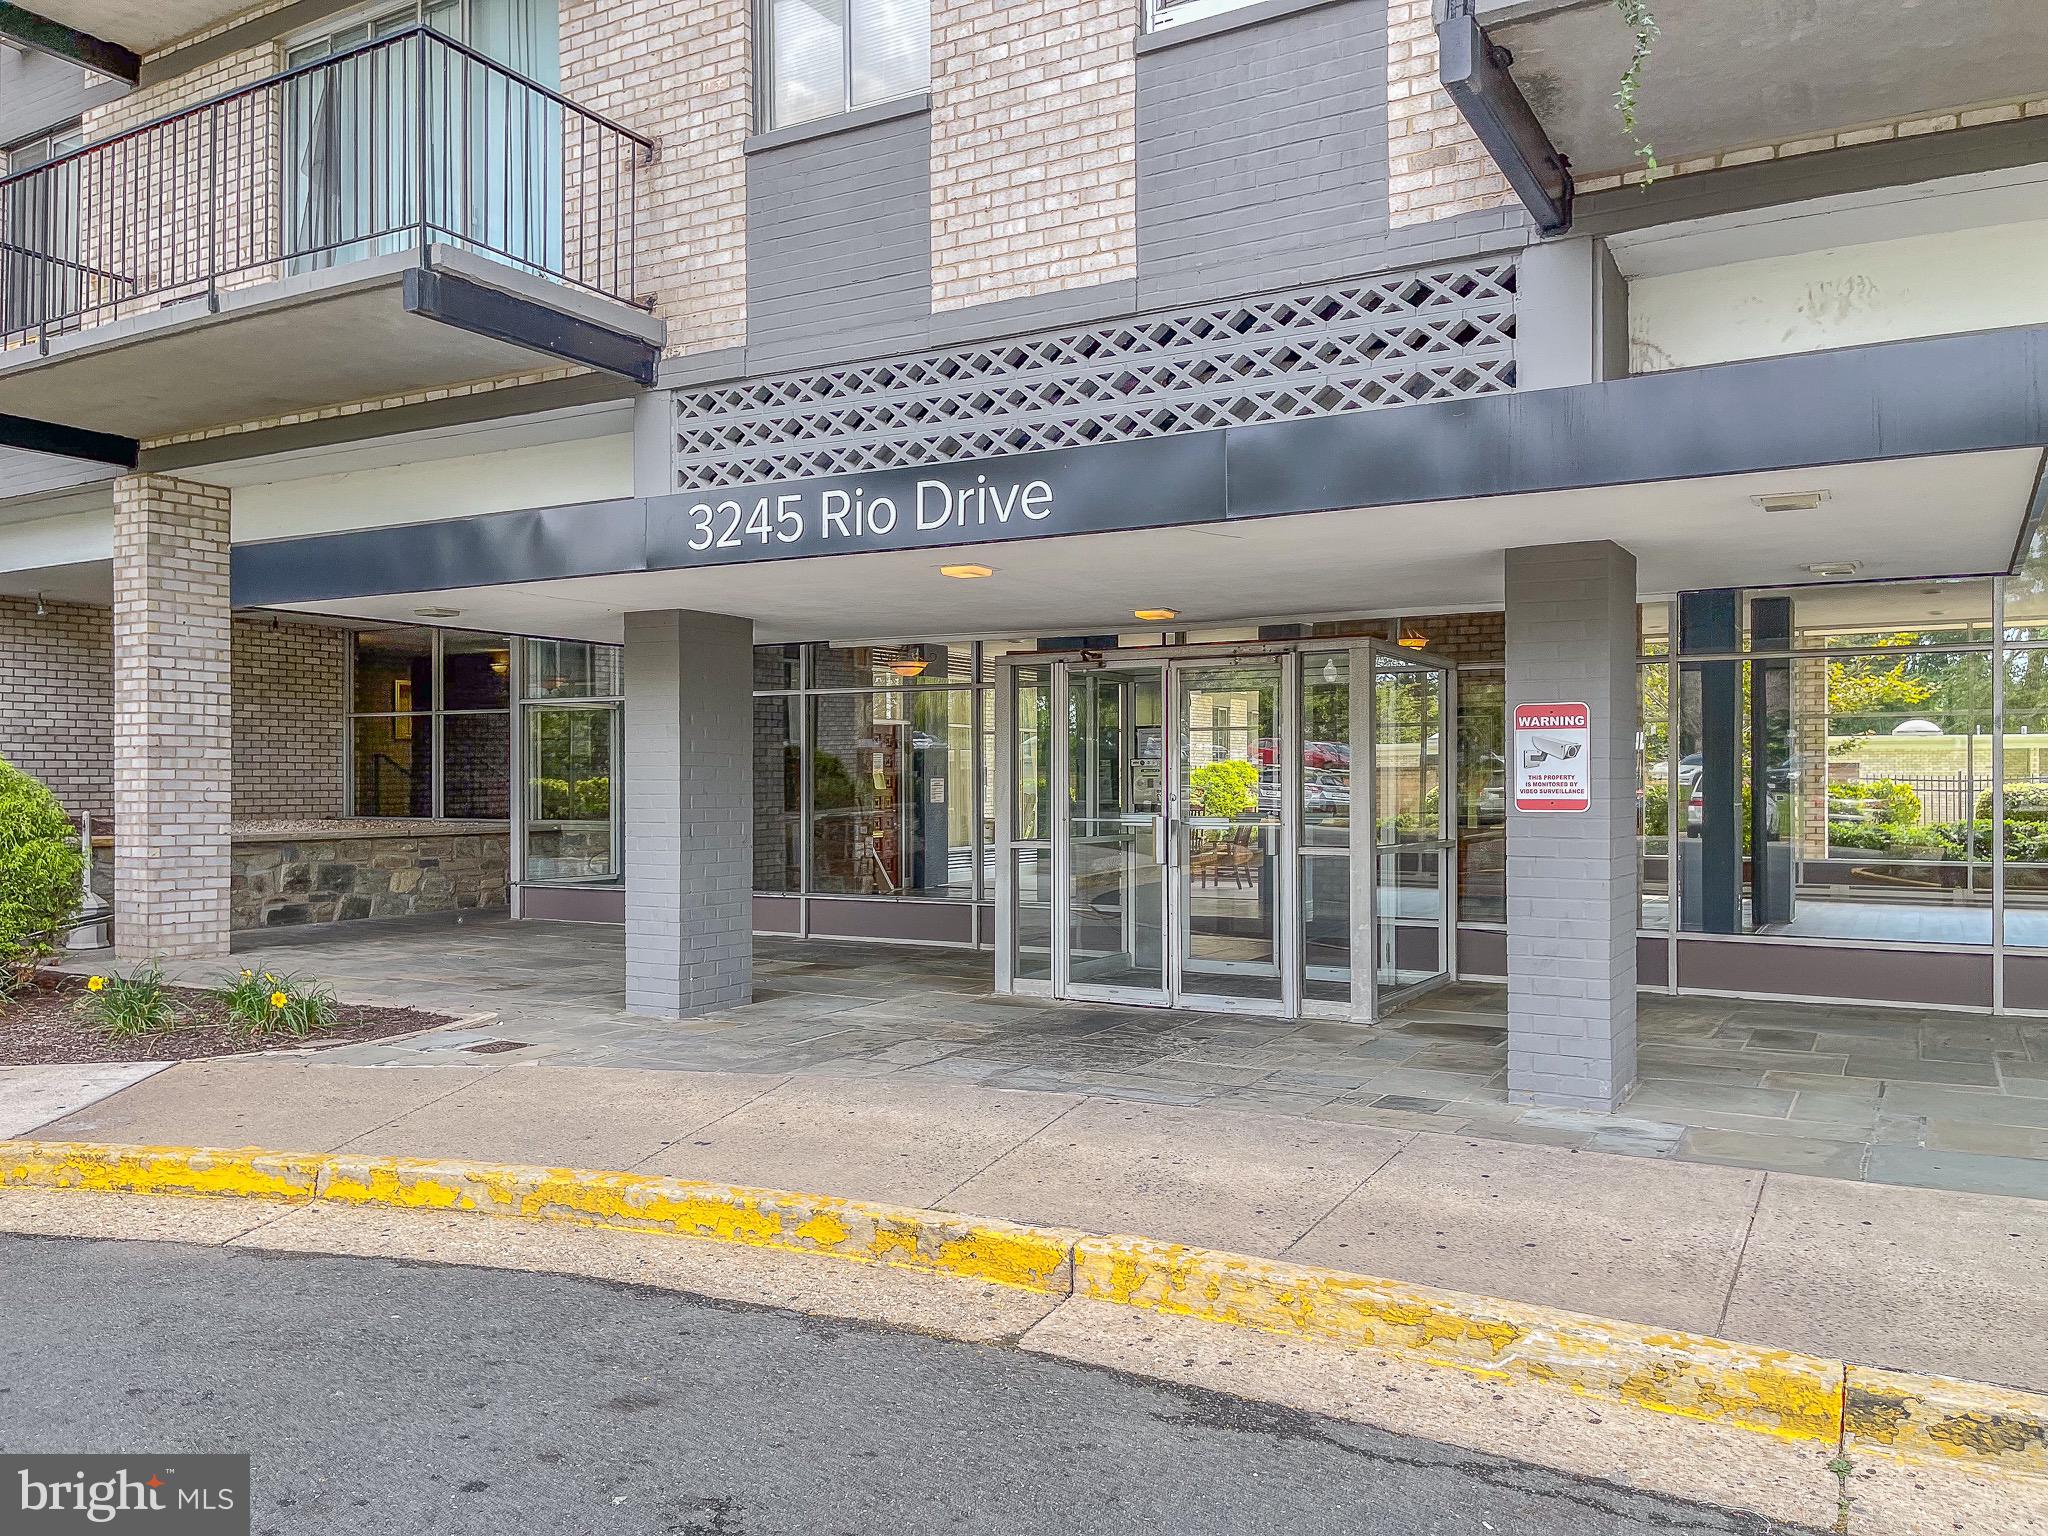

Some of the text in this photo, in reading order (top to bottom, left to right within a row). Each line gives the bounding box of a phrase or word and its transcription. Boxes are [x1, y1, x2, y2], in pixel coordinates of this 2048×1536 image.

[687, 475, 1053, 551] 3245 Rio Drive
[1518, 715, 1585, 727] WARNING
